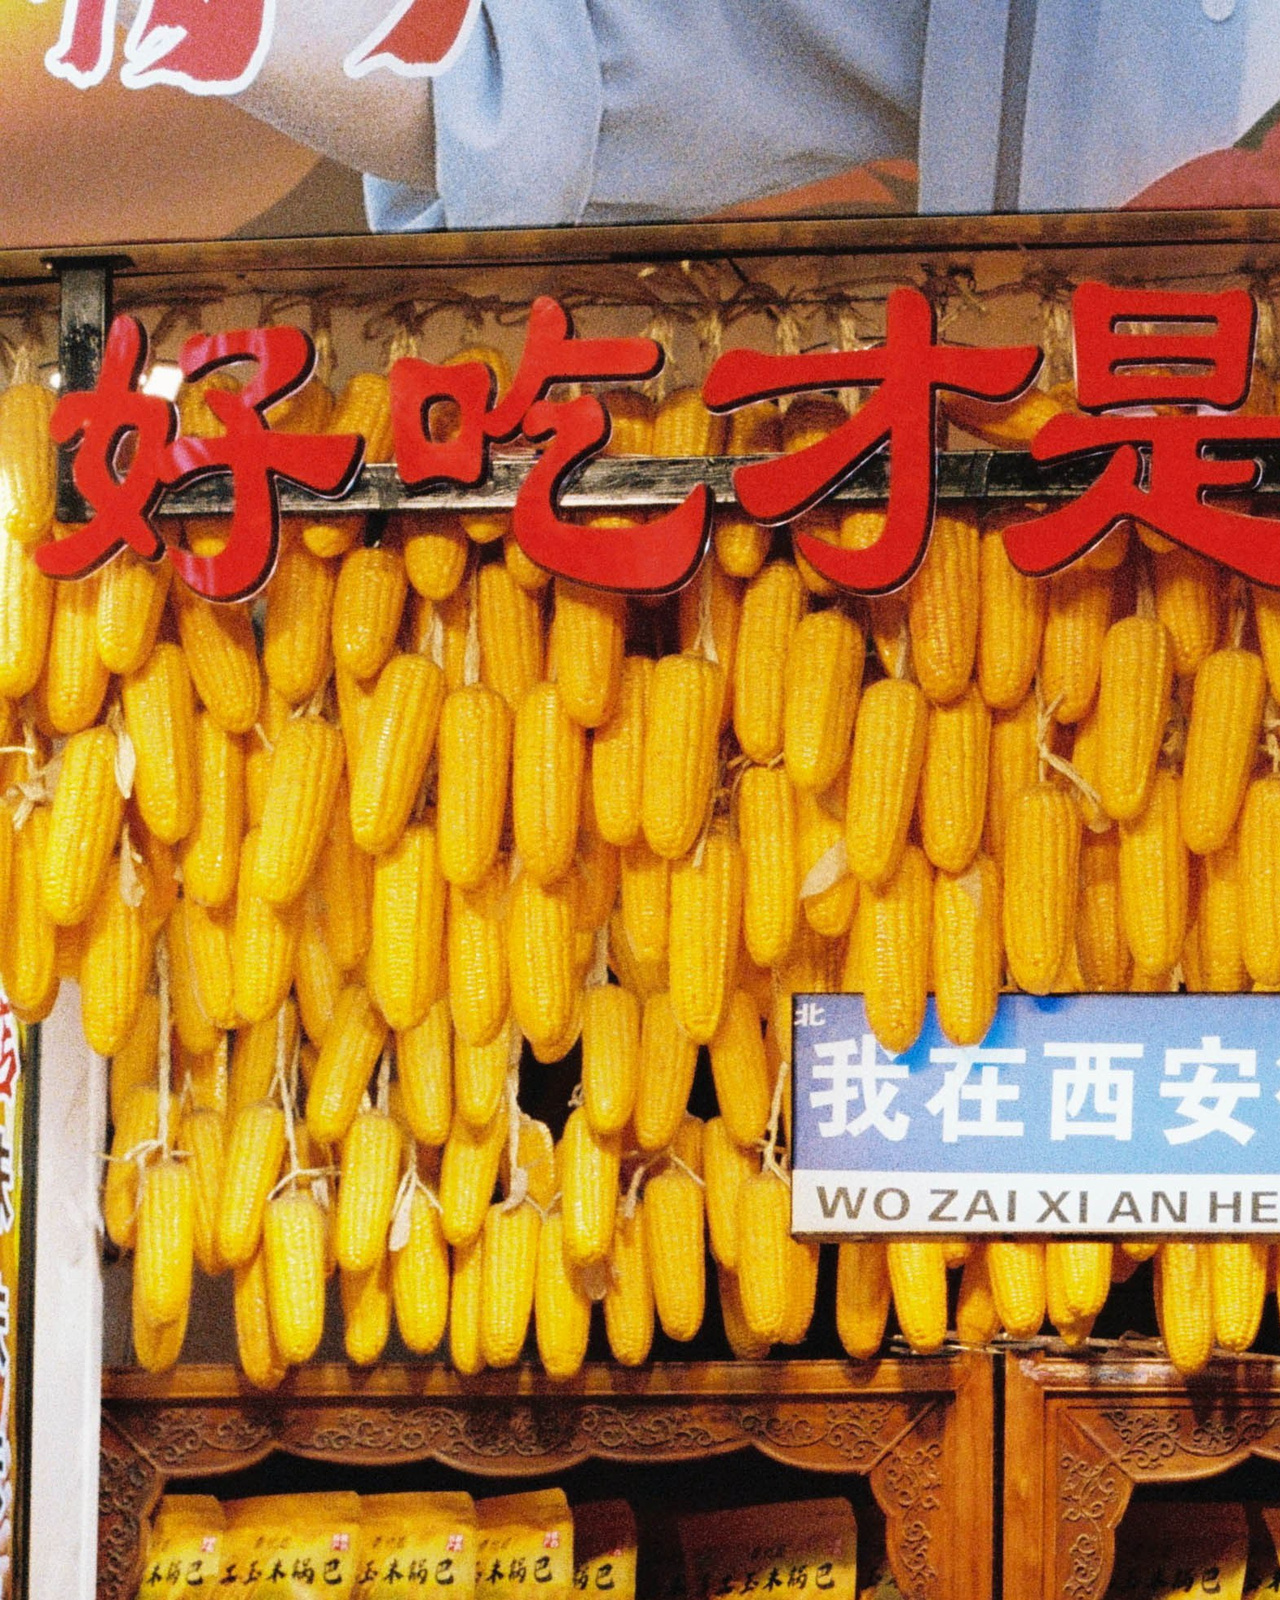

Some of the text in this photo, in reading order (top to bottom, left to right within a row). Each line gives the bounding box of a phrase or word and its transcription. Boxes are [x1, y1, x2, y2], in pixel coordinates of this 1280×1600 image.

[794, 1003, 826, 1027] 北
[815, 1186, 910, 1220] WO
[927, 1188, 1017, 1222] ZAI
[1037, 1189, 1089, 1223] XI
[1107, 1190, 1189, 1224] AN
